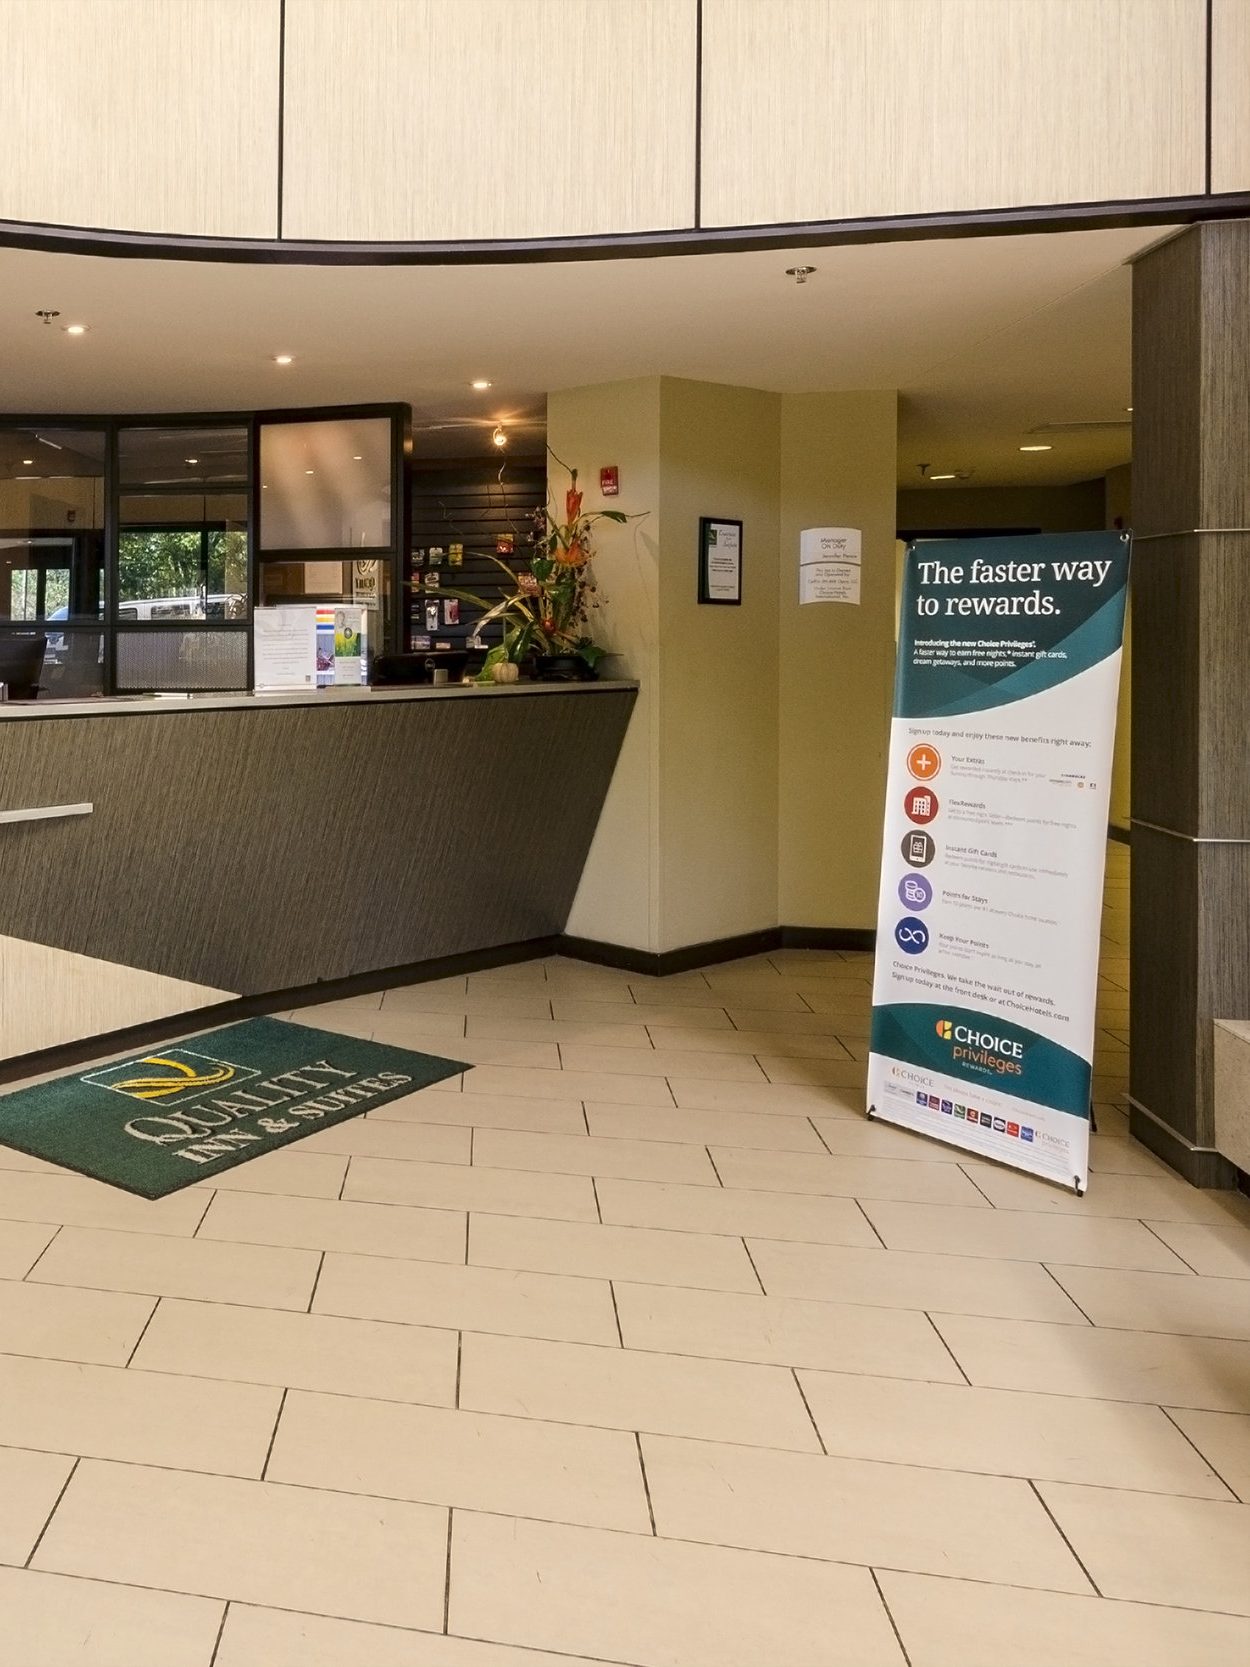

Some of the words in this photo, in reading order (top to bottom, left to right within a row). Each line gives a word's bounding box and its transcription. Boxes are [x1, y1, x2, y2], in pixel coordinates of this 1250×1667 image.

[918, 561, 964, 584] The
[969, 559, 1046, 584] faster
[1051, 560, 1113, 587] way
[916, 594, 939, 616] to
[944, 590, 1061, 616] rewards.
[914, 639, 949, 648] Introducing
[950, 639, 961, 647] the
[919, 648, 935, 656] faster
[1035, 650, 1047, 660] gift
[932, 730, 950, 738] today
[965, 732, 985, 740] enjoy
[1021, 736, 1049, 744] benefits
[1051, 738, 1068, 746] right
[966, 756, 985, 765] Extras
[945, 844, 967, 853] Instant
[968, 847, 979, 855] Gift
[980, 849, 998, 858] Cards
[942, 890, 961, 898] Points
[972, 895, 988, 904] Stays
[939, 933, 954, 942] Keep
[955, 936, 969, 944] Your
[970, 939, 989, 949] Points
[893, 961, 913, 970] Choice
[914, 966, 945, 979] Privileges.
[959, 977, 973, 985] take
[975, 981, 986, 989] the
[987, 984, 1002, 992] wait
[1003, 988, 1015, 996] out
[1025, 994, 1056, 1006] rewards.
[892, 971, 904, 981] Sign
[915, 978, 933, 989] today
[942, 984, 953, 992] the
[955, 986, 971, 997] front
[972, 992, 988, 1000] desk
[1006, 1000, 1070, 1022] ChoiceHotels.com
[954, 1026, 1023, 1059] CHOICE
[953, 1046, 1022, 1075] privileges
[901, 1070, 935, 1087] CHOICE
[124, 1060, 357, 1146] QUALITY
[171, 1128, 262, 1165] INN
[257, 1117, 301, 1133] &
[288, 1072, 413, 1120] SUITES
